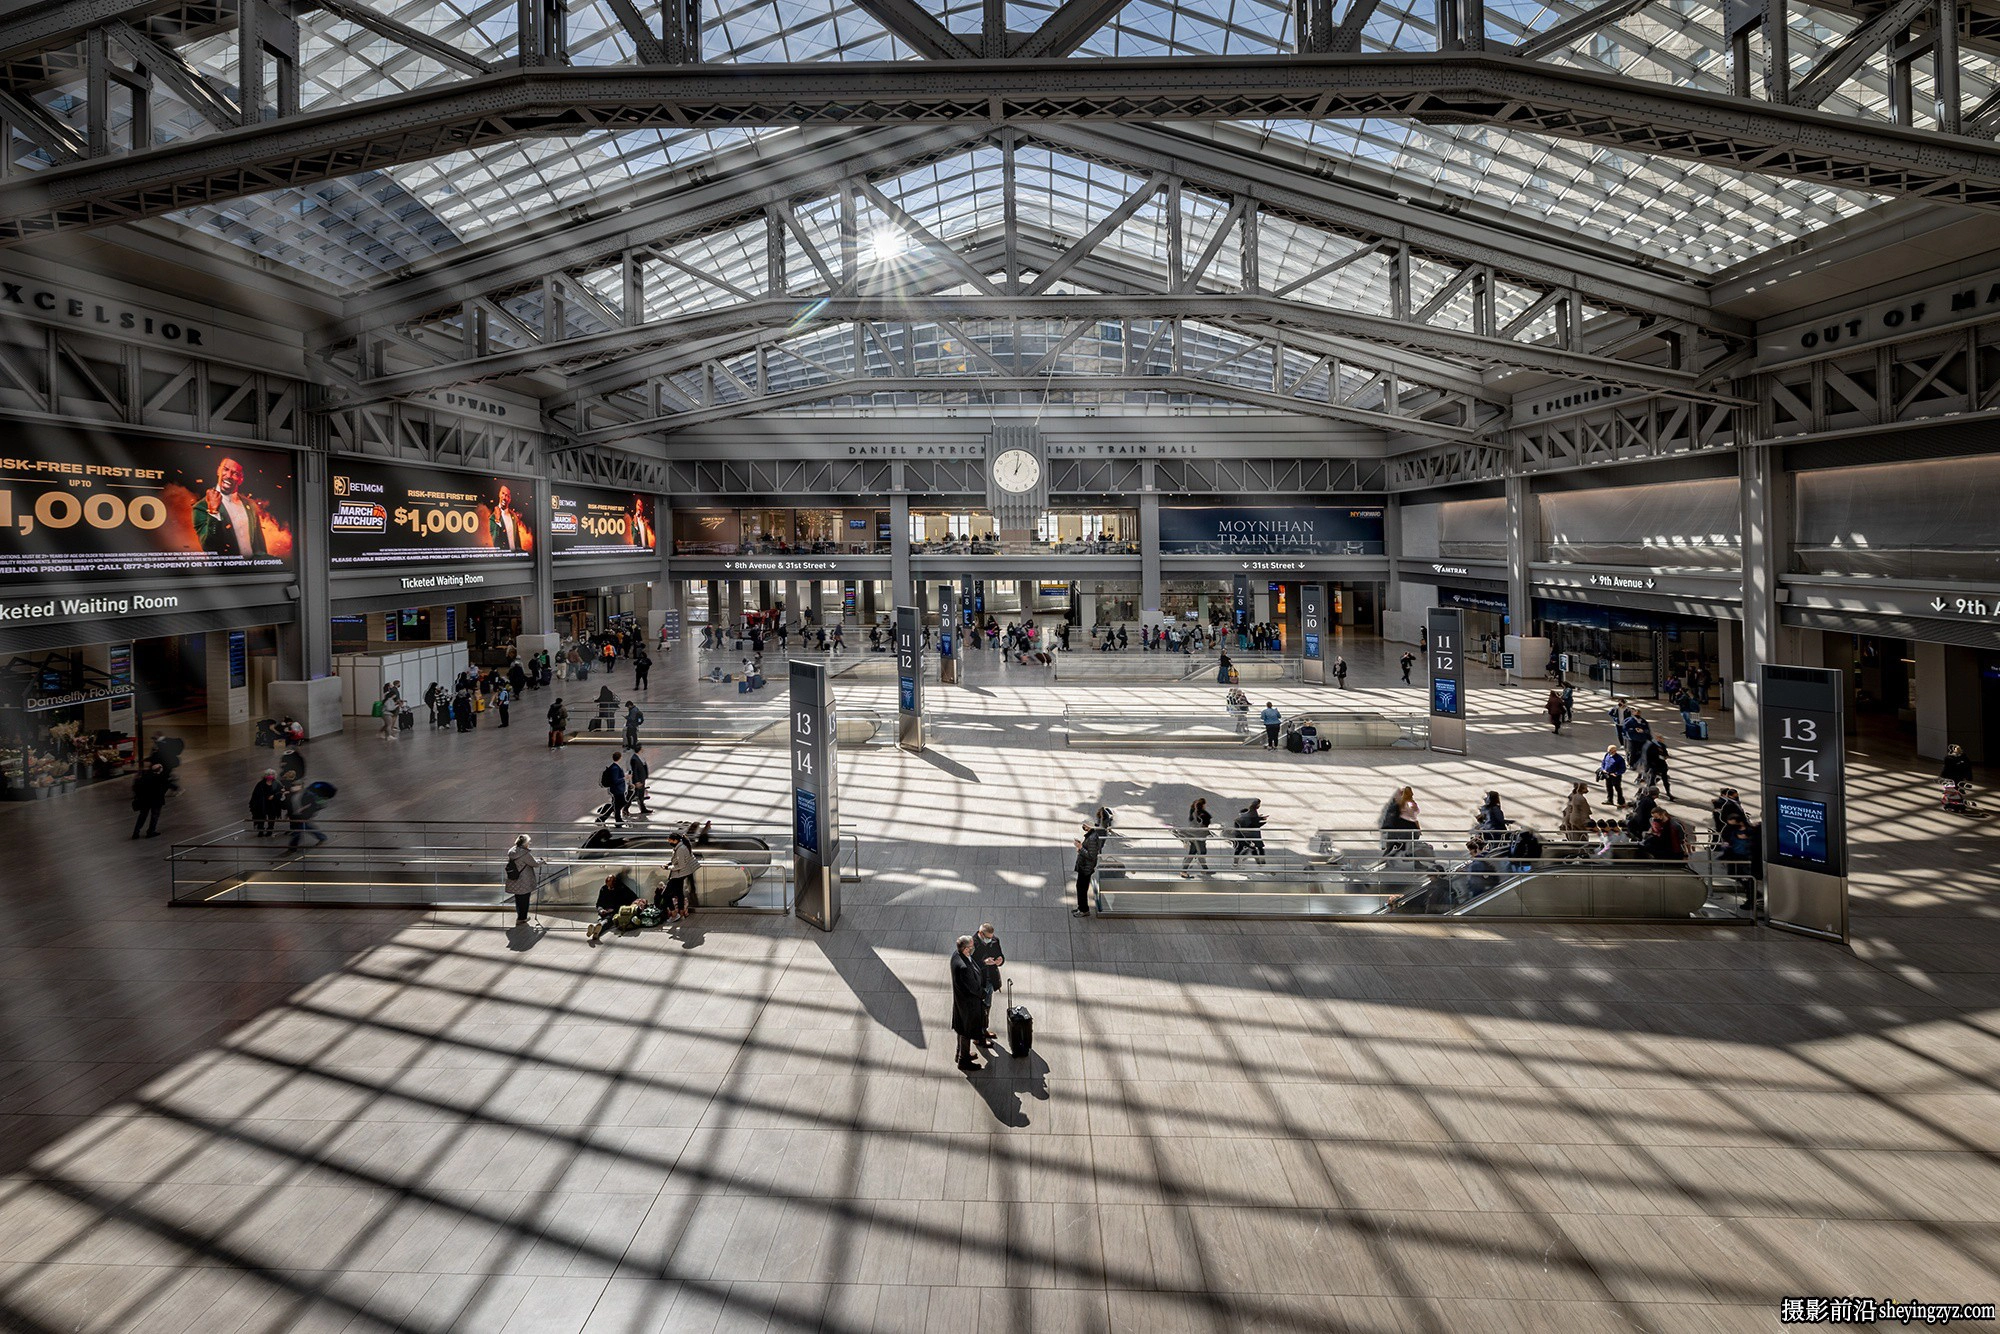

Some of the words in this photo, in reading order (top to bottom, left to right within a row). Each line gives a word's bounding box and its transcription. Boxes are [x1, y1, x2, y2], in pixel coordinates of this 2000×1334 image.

[1801, 319, 1861, 348] OUT
[1883, 303, 1926, 327] OF
[446, 393, 507, 416] UPWARD
[1546, 386, 1622, 412] PLURIBUS
[849, 446, 906, 455] DANIEL
[1097, 446, 1147, 454] TRAIN
[1158, 446, 1197, 454] HALL
[86, 465, 132, 477] FIRST
[135, 469, 165, 480] BET
[69, 479, 80, 487] UP
[81, 480, 92, 488] TO
[408, 489, 446, 500] RISK-FREE
[446, 492, 465, 501] FIRST
[465, 494, 478, 502] BET
[340, 506, 374, 516] MARCH
[333, 515, 384, 526] MATCHUPS
[394, 506, 479, 538] $1,000
[581, 515, 626, 538] $1,000
[1218, 520, 1315, 532] MOYNIHAN
[1217, 533, 1269, 545] TRAIN
[1275, 533, 1317, 545] HALL
[40, 564, 95, 573] PROBLEM?
[1252, 561, 1269, 569] 31st
[1270, 561, 1295, 569] Street
[1441, 566, 1468, 574] AMTRAK
[401, 576, 435, 588] Ticketed
[436, 575, 464, 586] Waiting
[464, 574, 484, 584] Room
[1599, 575, 1612, 586] 9th
[1613, 576, 1643, 588] Avenue
[61, 597, 128, 615] Waiting
[133, 595, 178, 610] Room
[942, 603, 948, 612] 9
[1307, 604, 1315, 613] 9
[1955, 598, 1987, 616] 9th
[942, 618, 950, 627] 10
[1306, 619, 1317, 628] 10
[902, 634, 910, 647] 11
[1437, 635, 1451, 648] 11
[901, 655, 912, 668] 12
[1437, 656, 1453, 670] 12
[27, 689, 88, 709] Damselfly
[89, 683, 131, 699] Flowers
[796, 711, 812, 736] 13
[1781, 717, 1818, 742] 13
[796, 750, 813, 775] 14
[1780, 756, 1820, 783] 14
[1780, 804, 1823, 816] MOYNIHAN
[1780, 809, 1803, 818] TRAIN
[1804, 813, 1824, 821] HALL
